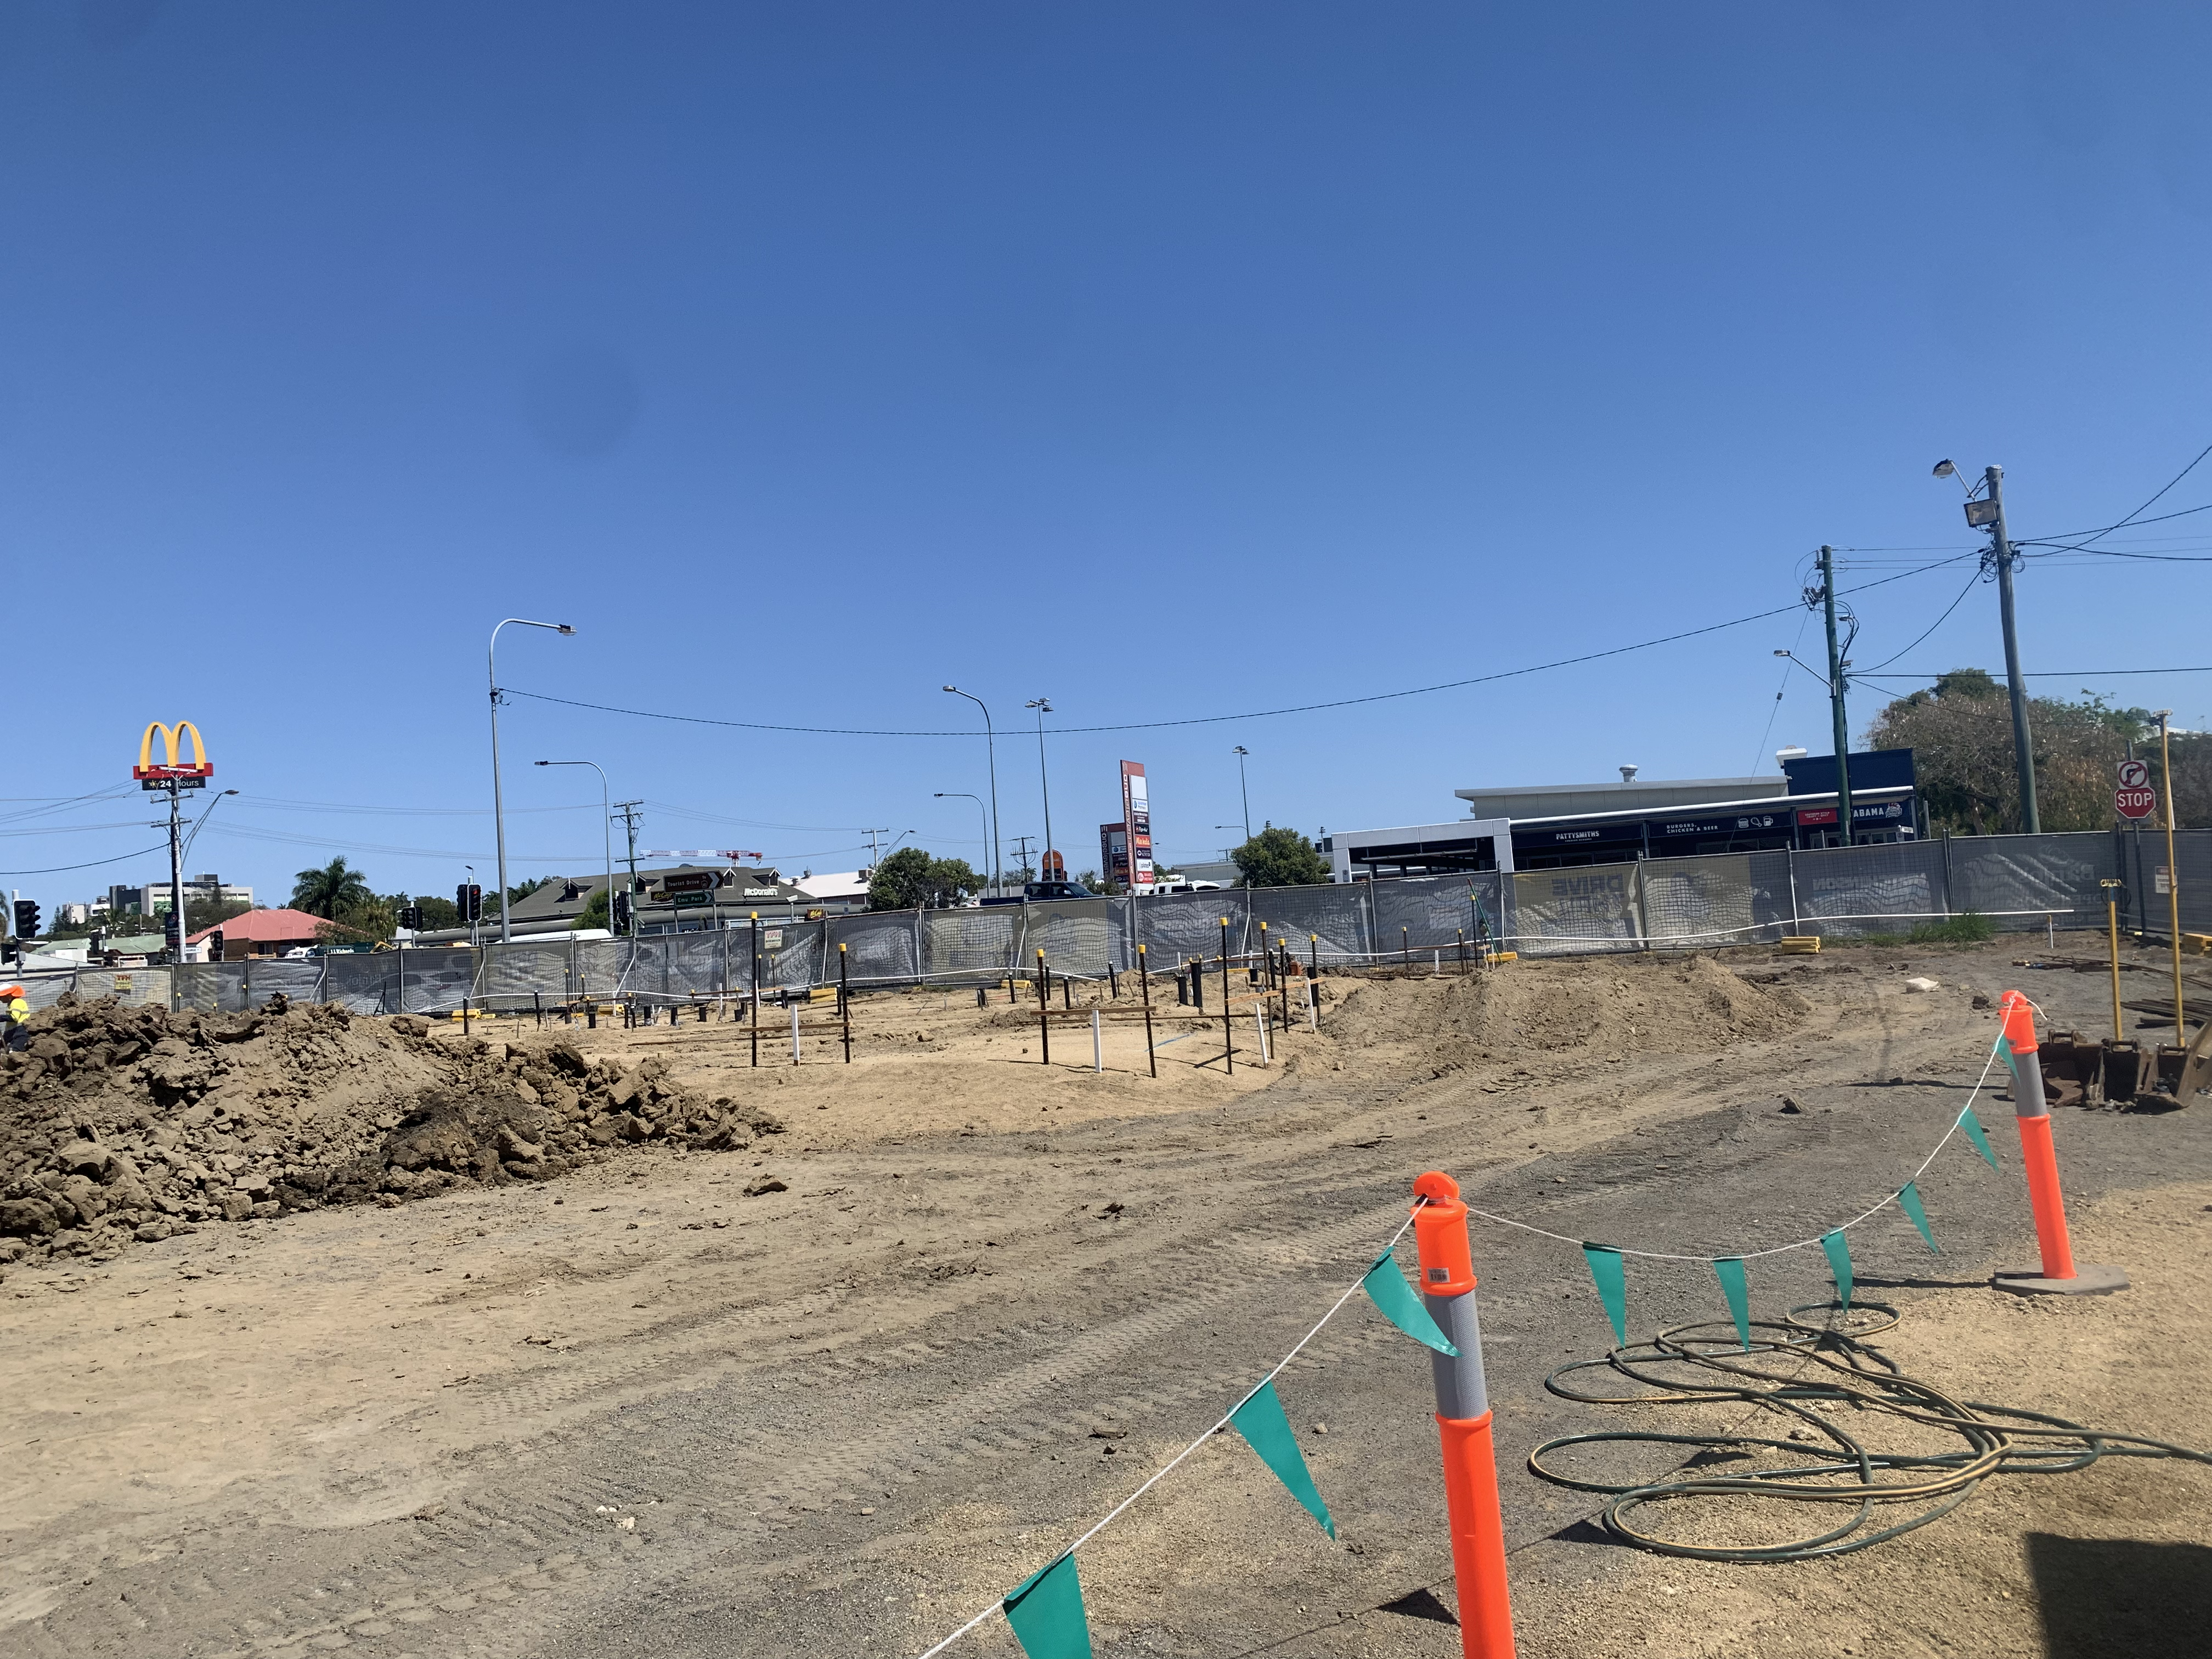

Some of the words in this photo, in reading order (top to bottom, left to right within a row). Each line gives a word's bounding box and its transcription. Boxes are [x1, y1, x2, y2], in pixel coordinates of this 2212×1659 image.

[2118, 793, 2152, 807] STOP
[1853, 808, 1884, 817] ABAMA
[1556, 831, 1599, 840] PATTYSMITHS
